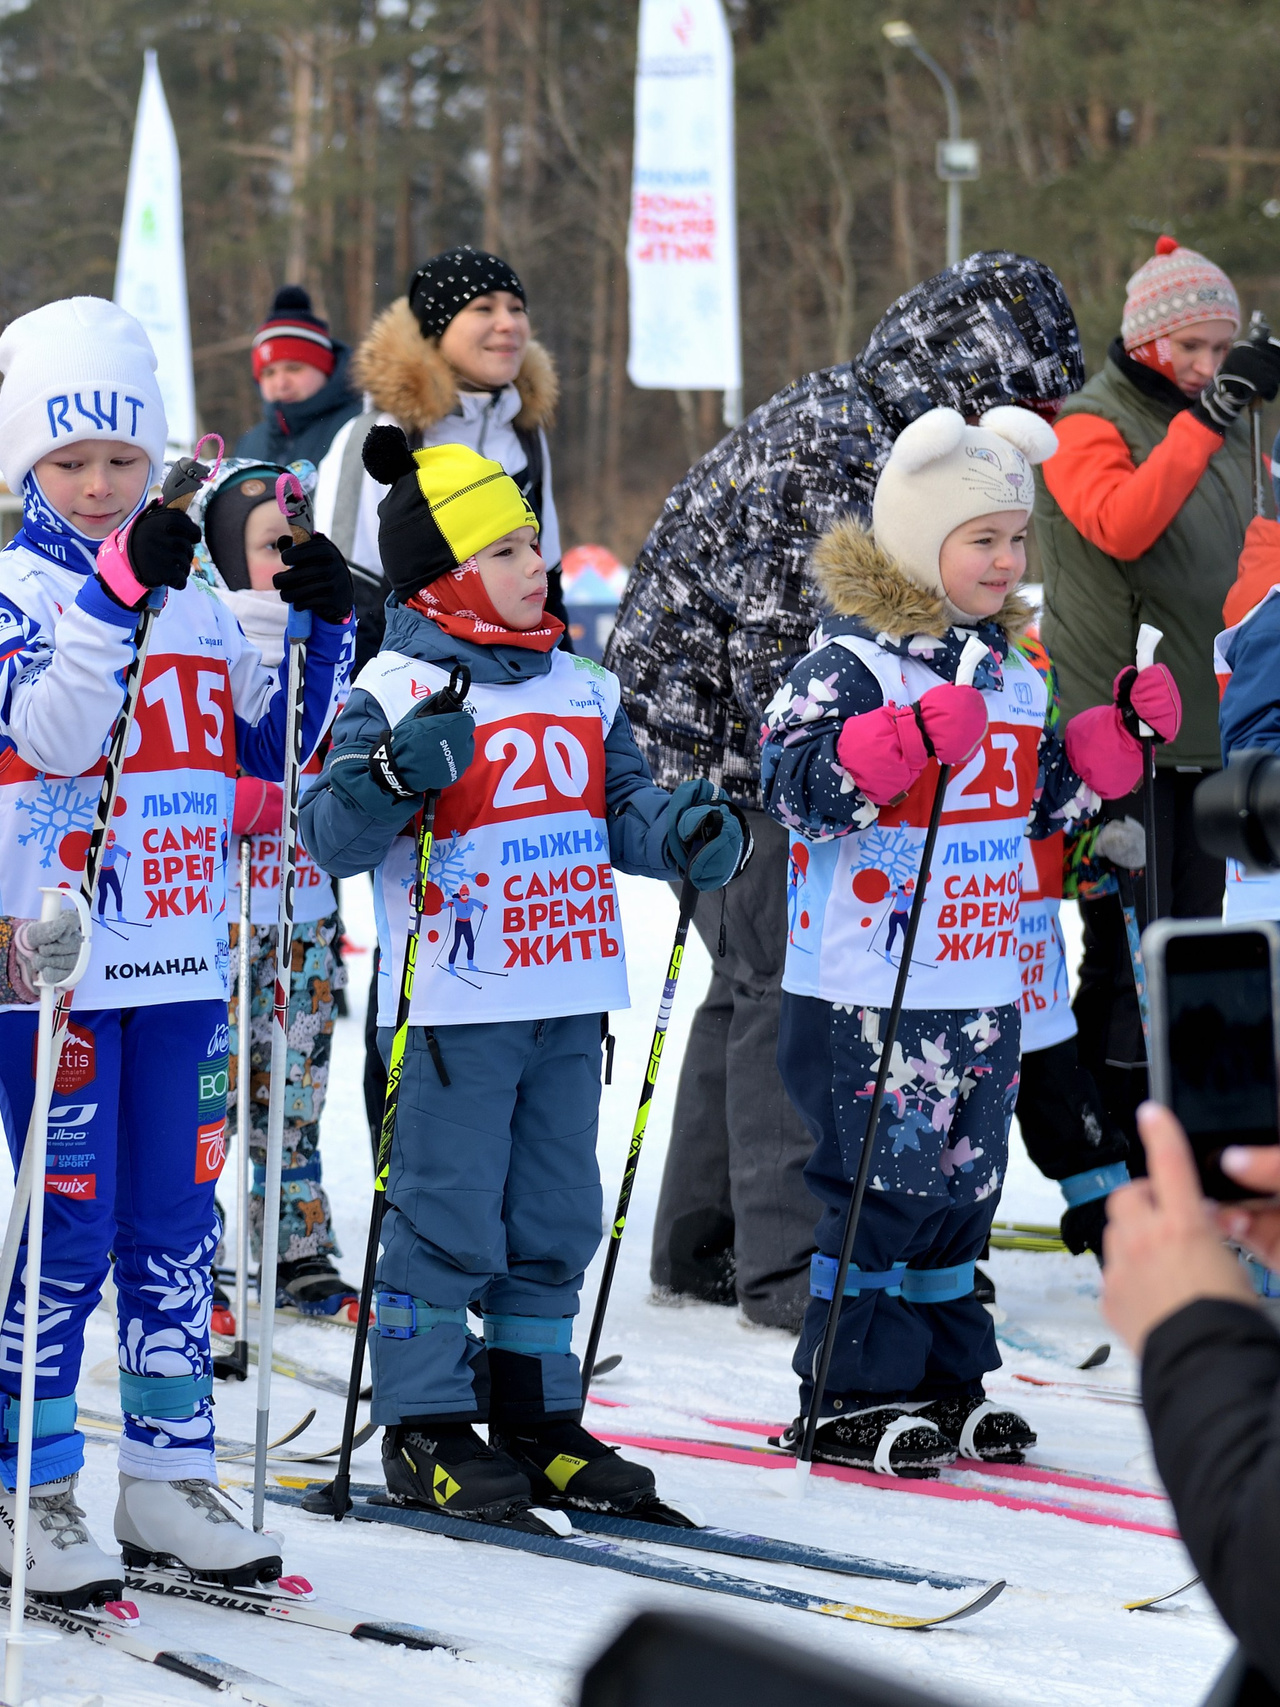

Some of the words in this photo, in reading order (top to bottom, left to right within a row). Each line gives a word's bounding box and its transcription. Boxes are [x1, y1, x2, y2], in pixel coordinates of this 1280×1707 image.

[46, 389, 145, 439] RWT
[484, 725, 589, 809] 20
[940, 732, 1020, 814] 23
[500, 828, 609, 866] ЛЫЖНЯ
[142, 854, 215, 888] ВРЕЯ
[502, 862, 614, 903] САМОЕ
[502, 893, 616, 934] ВРЕМЯ
[502, 927, 619, 969] ЖИТЬ
[105, 956, 209, 982] КОМАНДА
[57, 1050, 89, 1069] ttis
[46, 1128, 87, 1141] ulbo
[57, 1160, 90, 1168] SPORT
[124, 1574, 270, 1616] MADSHUS
